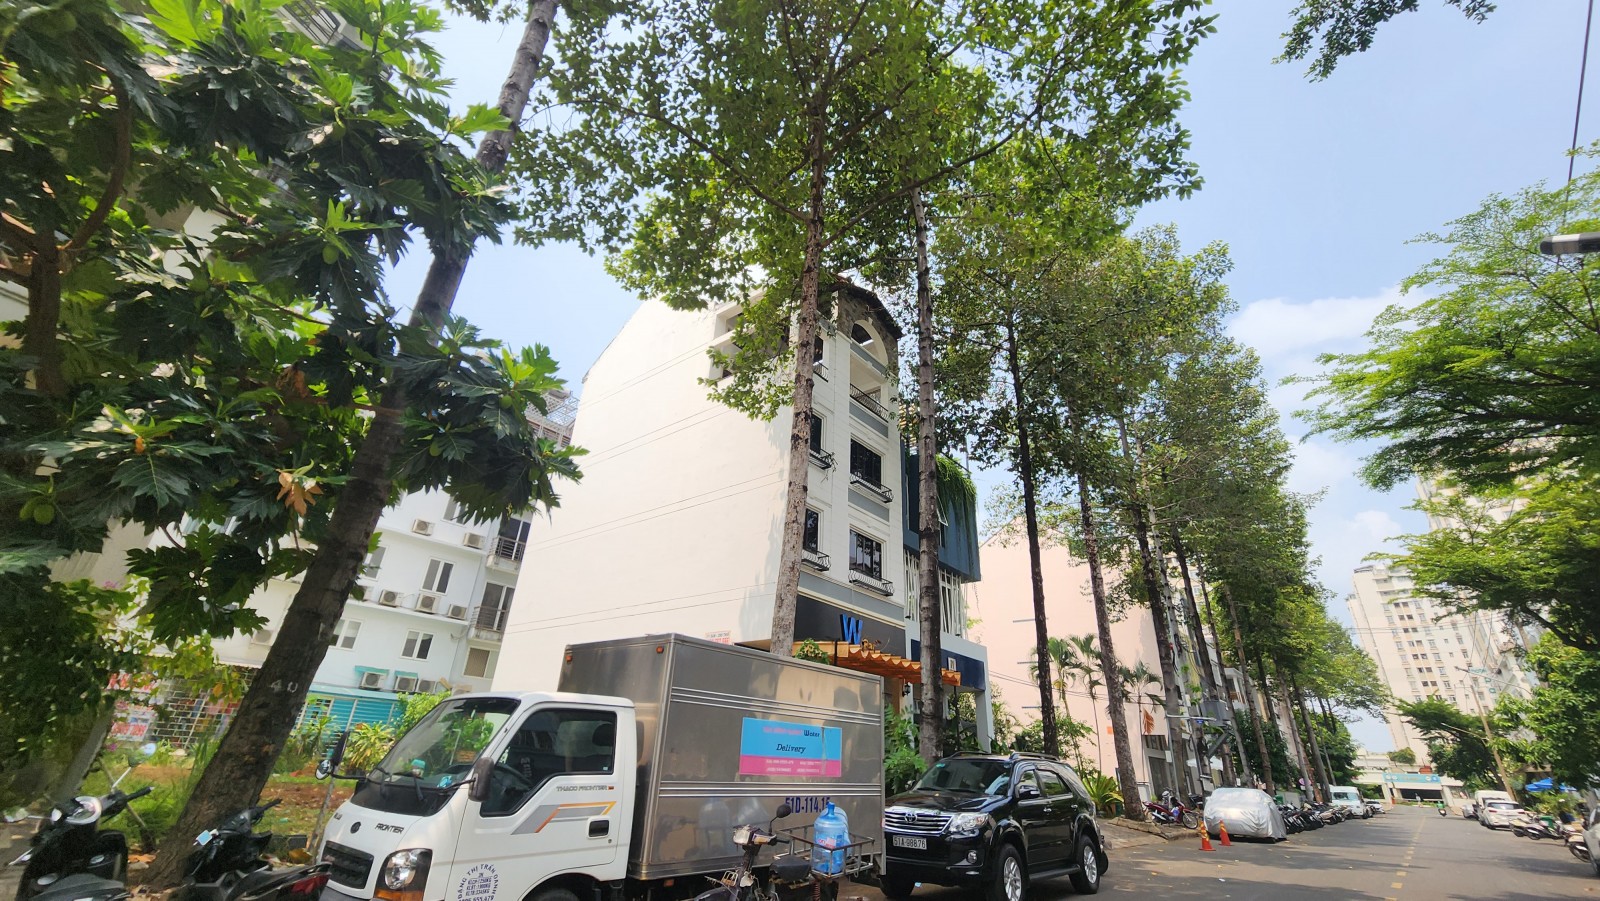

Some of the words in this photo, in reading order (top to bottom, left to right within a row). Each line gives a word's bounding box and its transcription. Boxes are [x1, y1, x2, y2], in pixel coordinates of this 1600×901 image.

[840, 614, 863, 645] W
[803, 729, 820, 737] Water
[776, 743, 806, 754] Delivery
[375, 822, 404, 834] FRONTIER
